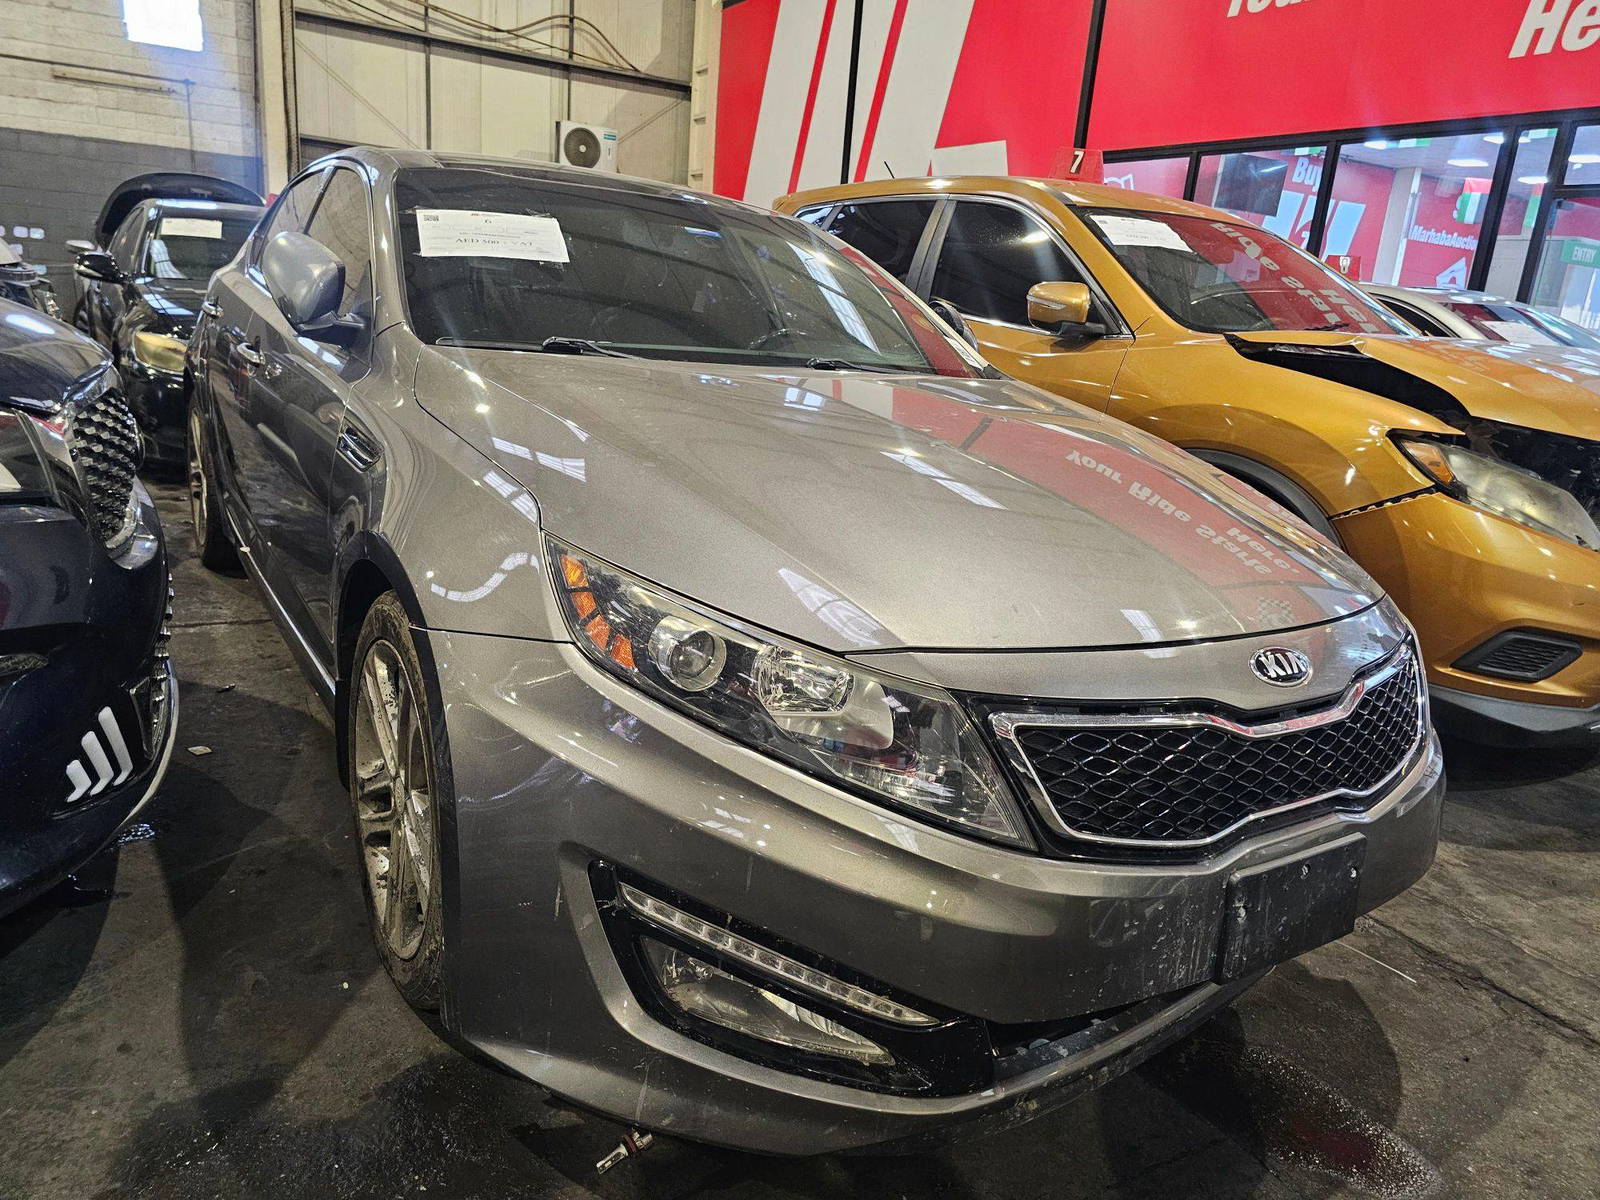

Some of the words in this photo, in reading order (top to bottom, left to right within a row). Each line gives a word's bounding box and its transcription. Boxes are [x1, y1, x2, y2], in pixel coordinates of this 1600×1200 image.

[1070, 150, 1084, 174] 7
[1571, 246, 1598, 263] ENTRY
[1258, 652, 1307, 678] KIA
